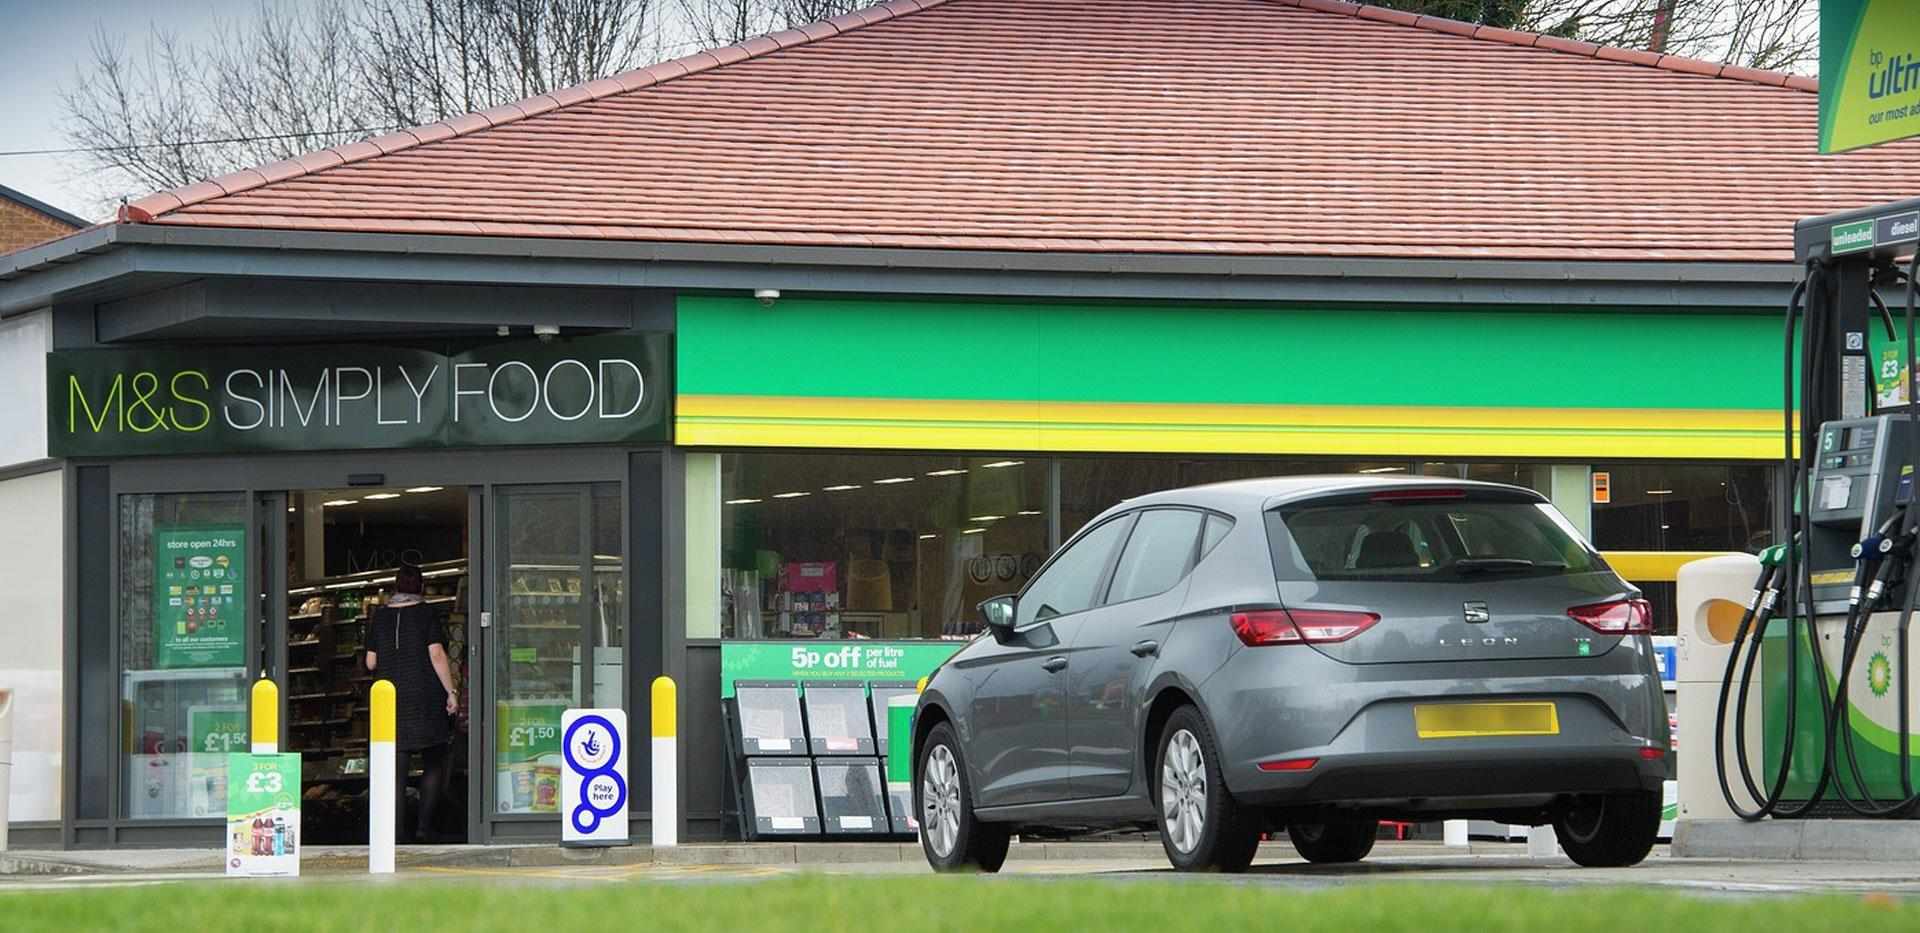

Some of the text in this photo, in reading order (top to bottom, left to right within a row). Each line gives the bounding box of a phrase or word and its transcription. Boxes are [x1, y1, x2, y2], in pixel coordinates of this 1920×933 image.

[1870, 48, 1883, 69] bp
[1869, 111, 1884, 125] our
[1886, 105, 1908, 121] most
[1891, 219, 1918, 236] diesel
[1833, 228, 1873, 246] unleaded
[1881, 359, 1898, 378] £3
[69, 358, 645, 434] M&S SIMPLY FOOD
[1823, 431, 1834, 450] 5
[167, 538, 237, 550] store open 24hrs
[1439, 637, 1518, 647] LEON
[791, 645, 862, 668] 5p off
[866, 647, 904, 659] per litre
[866, 657, 897, 668] of fuel
[509, 727, 555, 747] £1.50
[246, 772, 283, 793] £3
[593, 783, 613, 793] Play
[593, 792, 614, 801] here
